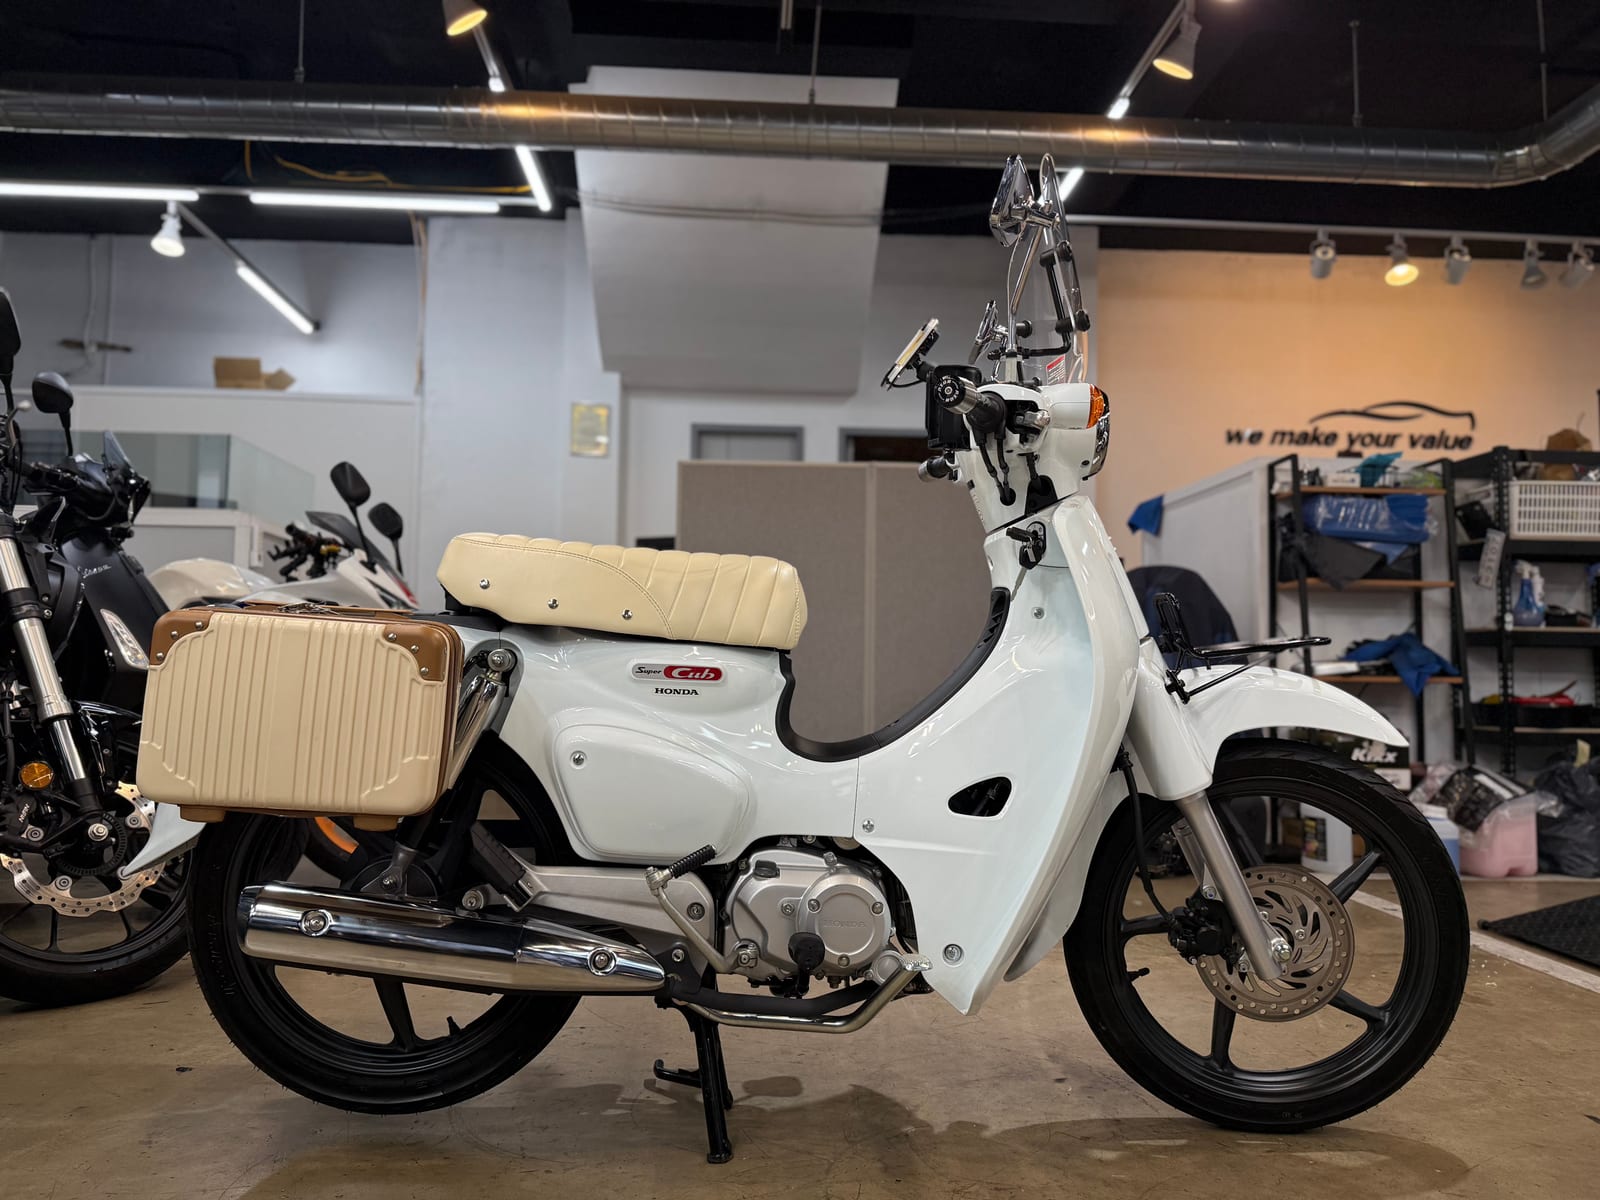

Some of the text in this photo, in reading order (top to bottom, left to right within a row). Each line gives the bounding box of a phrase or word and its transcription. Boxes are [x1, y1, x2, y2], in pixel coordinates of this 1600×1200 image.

[1225, 426, 1473, 453] we make your value
[635, 666, 715, 679] Super Cub
[655, 688, 699, 696] HONDA
[823, 919, 867, 929] HONDA
